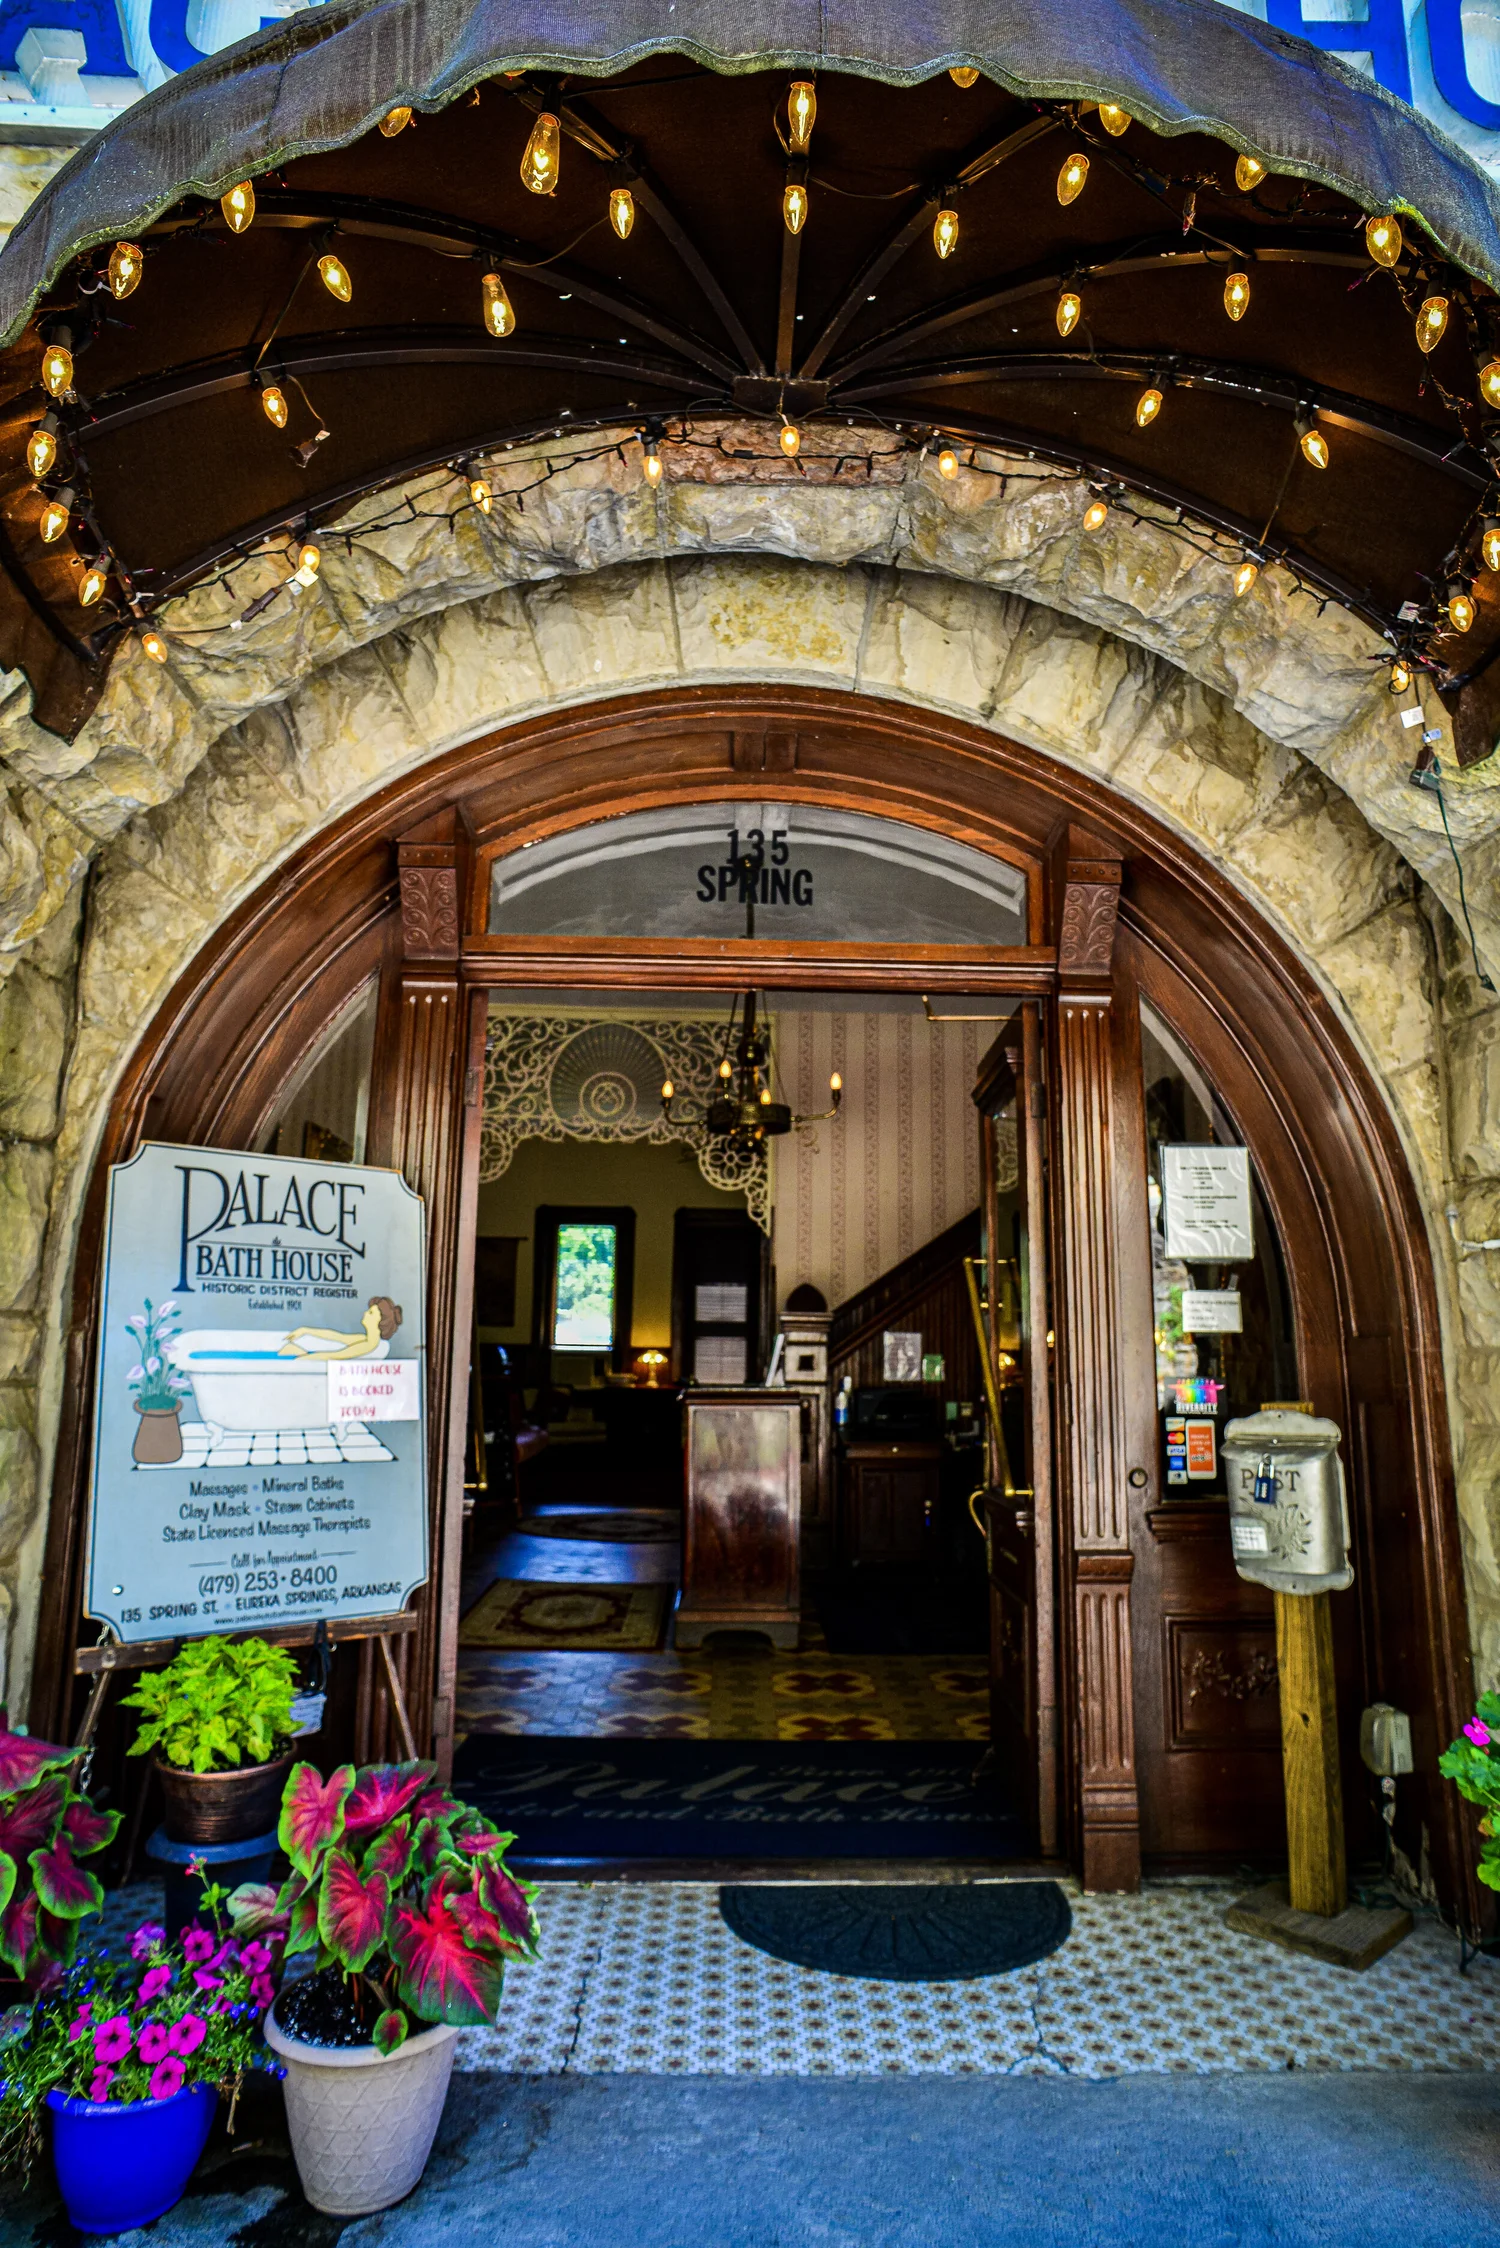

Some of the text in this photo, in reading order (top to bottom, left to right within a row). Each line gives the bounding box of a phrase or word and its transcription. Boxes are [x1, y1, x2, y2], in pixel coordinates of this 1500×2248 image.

[726, 829, 789, 866] 135
[696, 865, 813, 906] SPRING
[172, 1165, 366, 1292] PALACE
[196, 1245, 354, 1283] BATH HOUSE
[202, 1283, 359, 1299] HISTORIC DISTRICT REGISTER
[189, 1476, 345, 1499] Massages Mineral Baths
[1241, 1469, 1300, 1491] PST
[179, 1497, 355, 1522] Clay Mask Steam Cabinets
[162, 1516, 371, 1543] State Licensed Massage Therapists
[198, 1573, 240, 1596] (479)
[121, 1608, 142, 1623] 135
[149, 1603, 197, 1621] SPRING
[236, 1594, 281, 1611] EUREKA
[342, 1581, 402, 1601] ARKANSAS
[472, 1760, 973, 1802] Palace
